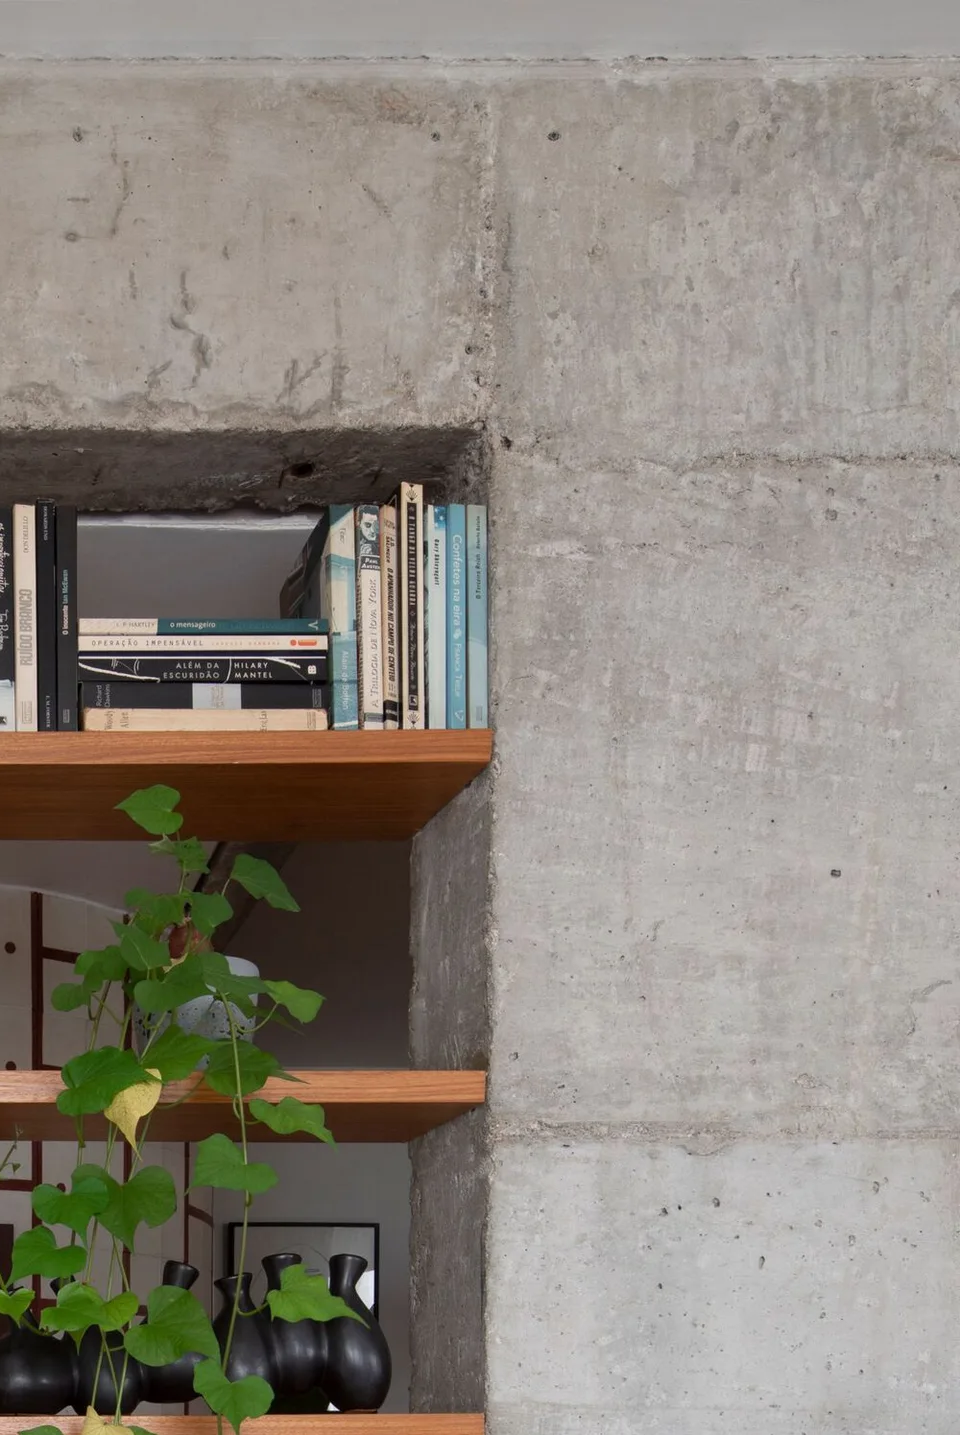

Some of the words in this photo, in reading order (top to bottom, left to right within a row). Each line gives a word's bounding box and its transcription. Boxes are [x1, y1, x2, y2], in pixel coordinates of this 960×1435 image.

[452, 534, 463, 586] Confetes
[452, 588, 460, 602] na
[19, 589, 32, 632] BRANCO
[388, 610, 394, 621] NO
[453, 605, 461, 626] eira
[176, 622, 216, 630] mensageiro
[370, 638, 378, 650] DE
[388, 646, 394, 654] DE
[370, 654, 378, 696] TRILOGIA
[341, 684, 350, 710] Botton
